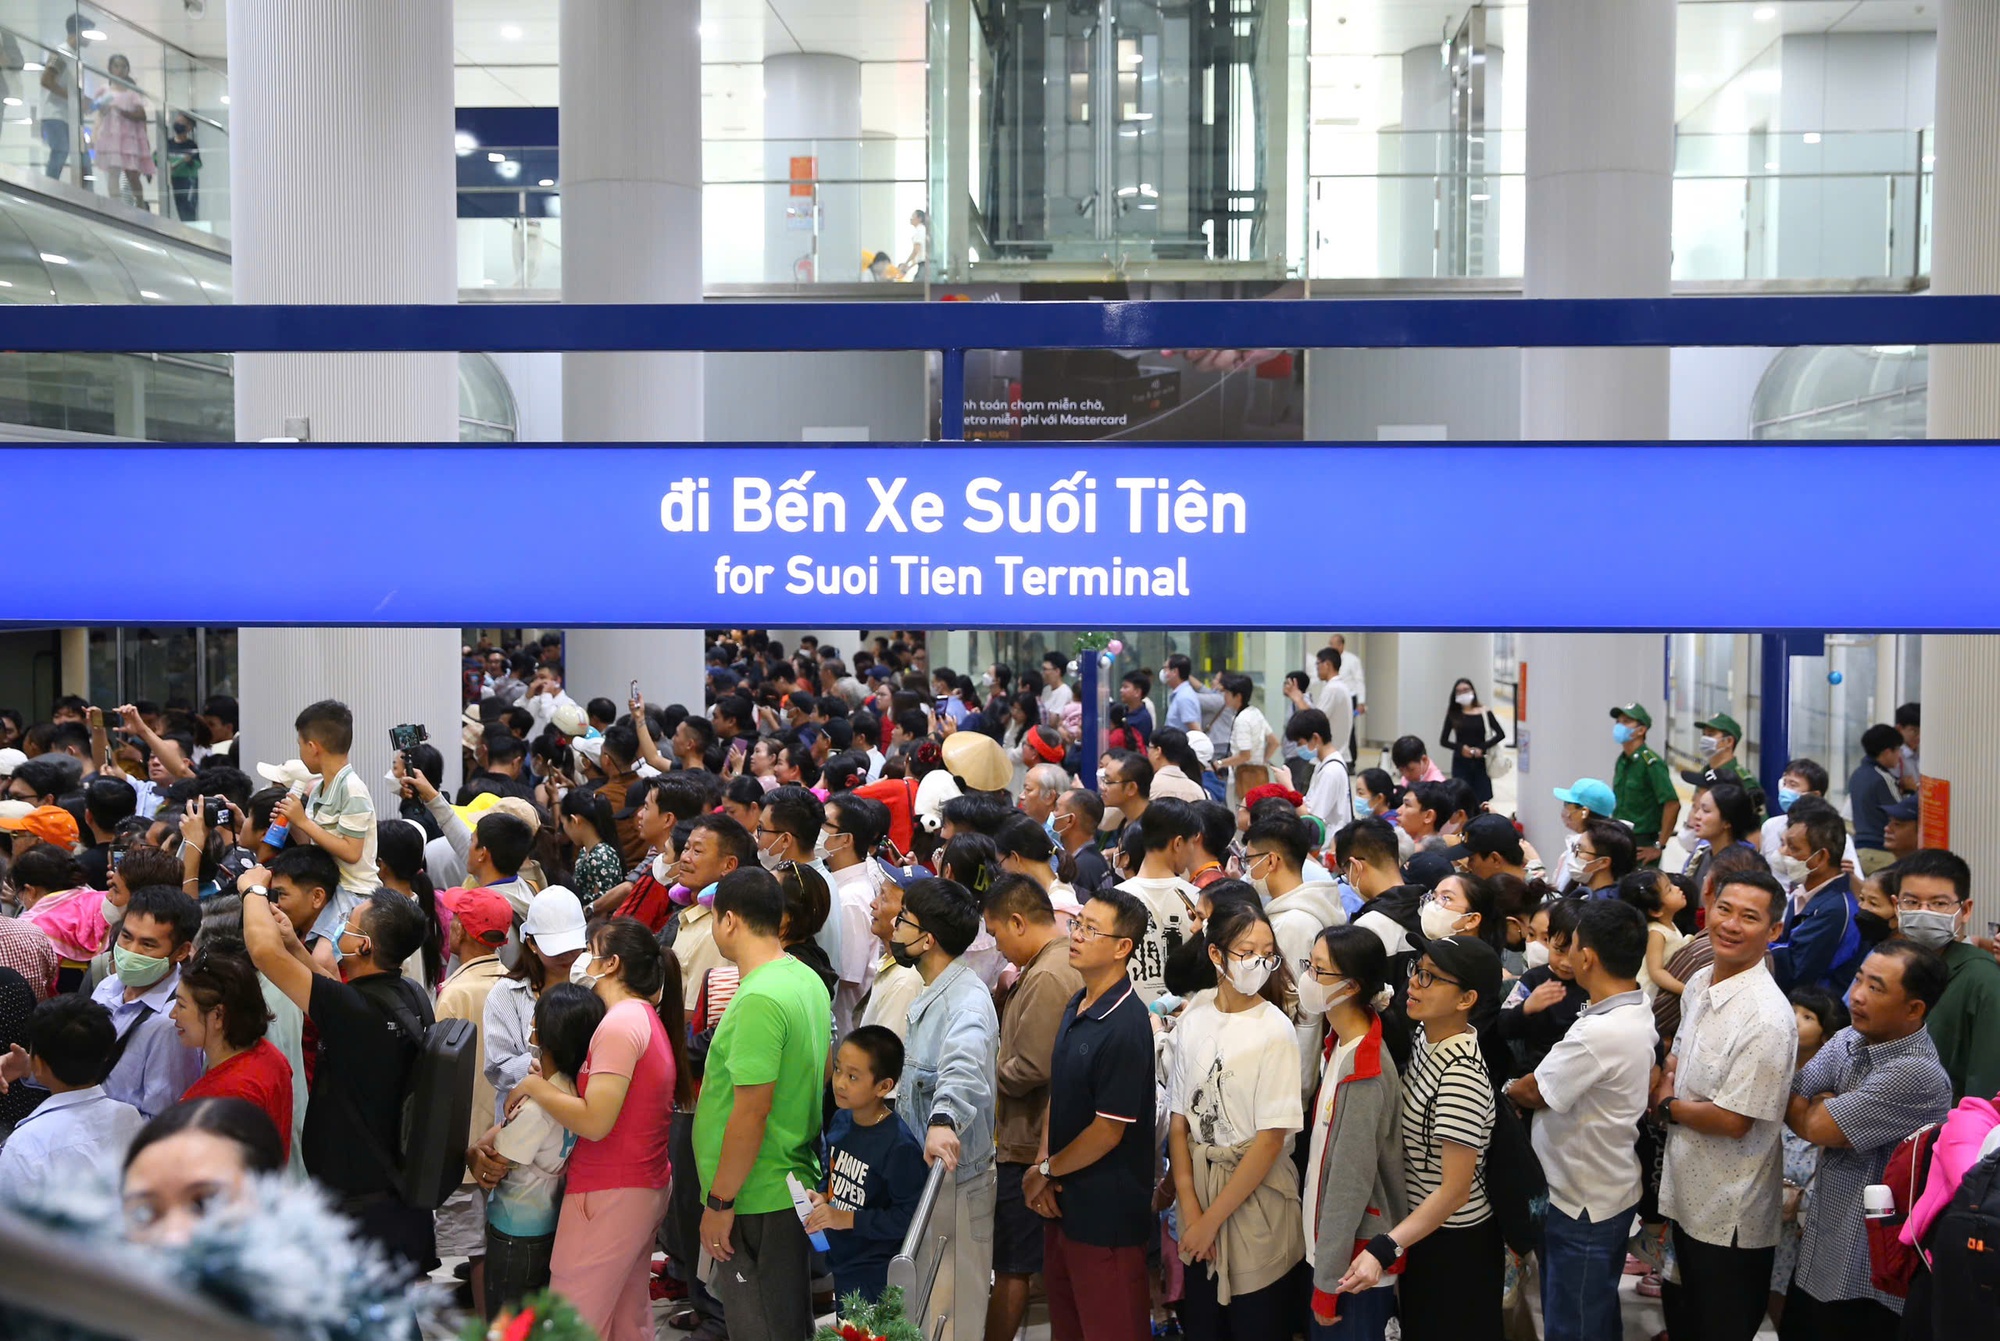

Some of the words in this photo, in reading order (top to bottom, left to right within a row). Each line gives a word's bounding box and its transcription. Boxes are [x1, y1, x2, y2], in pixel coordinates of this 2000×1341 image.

[963, 414, 988, 426] etro
[989, 412, 1019, 426] miễn
[1020, 413, 1039, 428] phí
[1059, 413, 1128, 426] Mastercard
[979, 399, 1008, 411] toán
[1010, 399, 1045, 413] chạm
[1047, 397, 1078, 411] miễn
[1079, 399, 1105, 412] chờ,
[660, 477, 710, 533] đi
[733, 470, 846, 533] Bến
[865, 477, 945, 533] Xe
[962, 470, 1097, 534] Suối
[1115, 477, 1246, 534] Tiên
[714, 555, 775, 594] for
[785, 555, 878, 595] Suoi
[890, 555, 982, 596] Tien
[994, 555, 1190, 597] Terminal
[834, 1150, 869, 1185] HAVE
